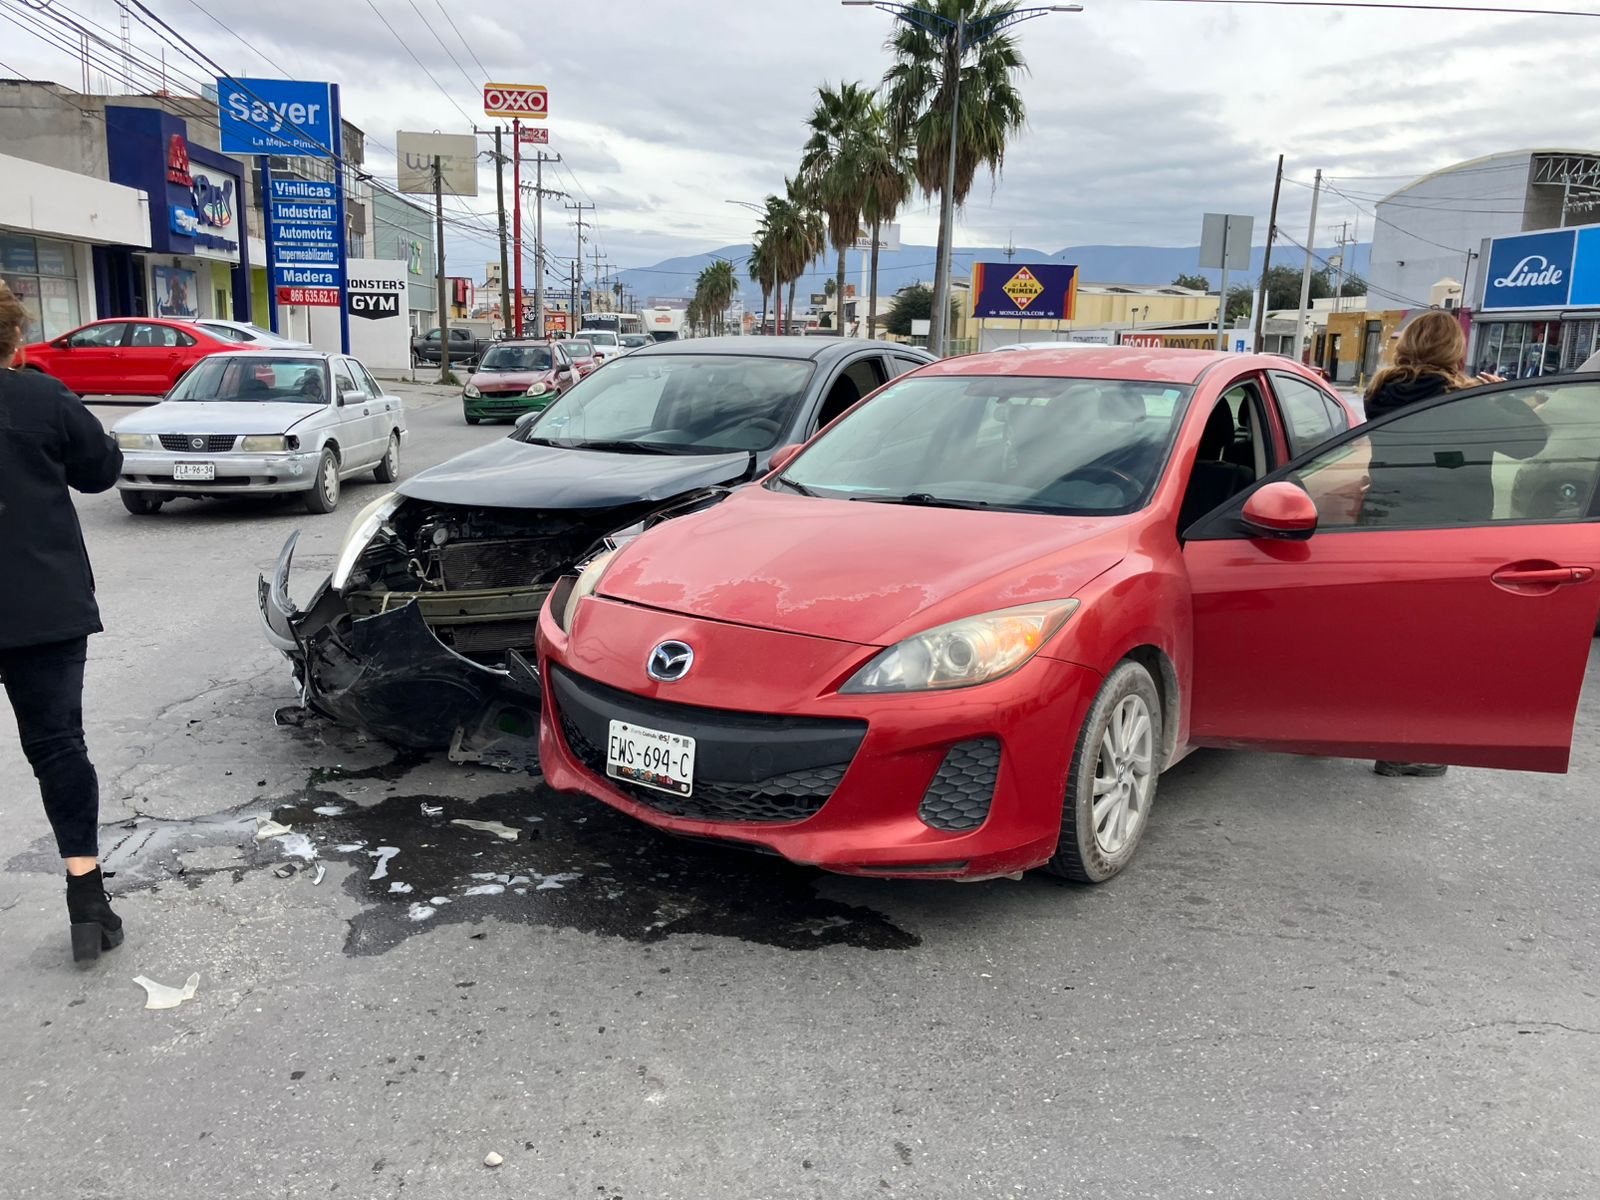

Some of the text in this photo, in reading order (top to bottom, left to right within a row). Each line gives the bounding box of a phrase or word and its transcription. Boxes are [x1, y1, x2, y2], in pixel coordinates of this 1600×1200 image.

[487, 91, 545, 110] OXXO
[228, 92, 320, 132] Sayer
[252, 137, 264, 146] La
[293, 139, 326, 149] Pintua
[275, 182, 331, 197] Vinilicas
[278, 204, 331, 219] Industrial
[279, 225, 333, 240] Automotriz
[278, 247, 334, 263] Impermeabilizante
[283, 269, 333, 283] Madera
[1494, 255, 1563, 287] Linde
[347, 279, 405, 290] ONSTER'S
[290, 289, 338, 304] 866 635.62.17
[352, 295, 396, 310] GYM
[610, 735, 690, 778] EWS-694-C
